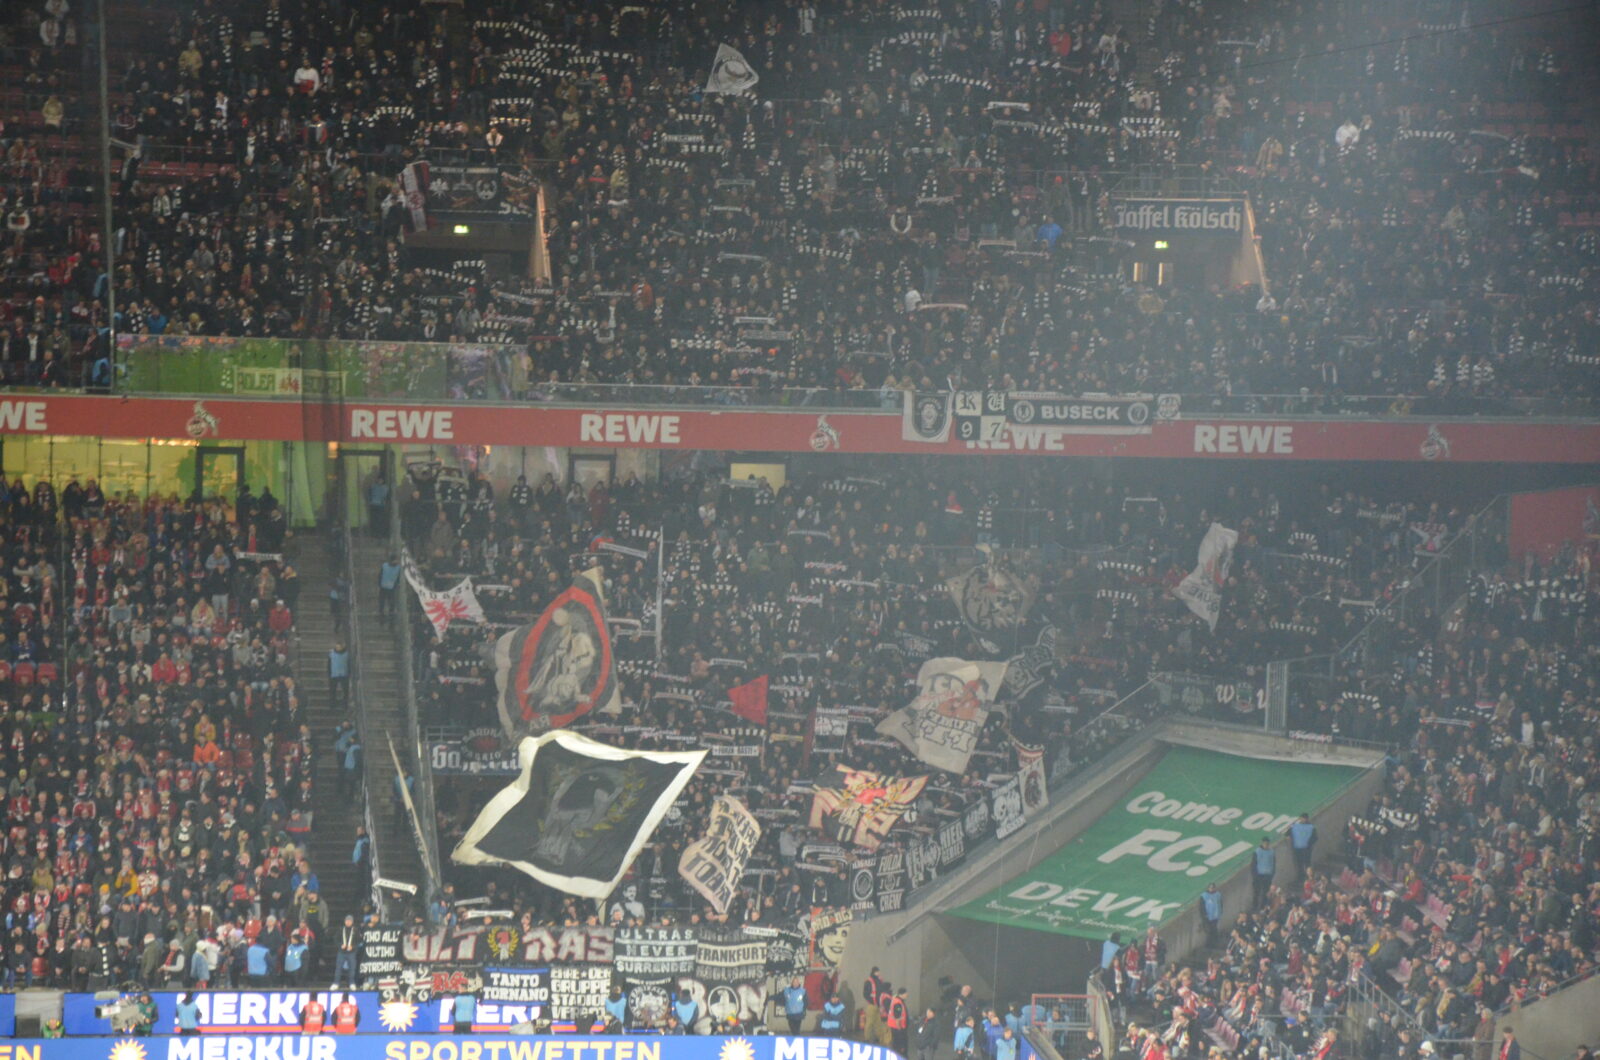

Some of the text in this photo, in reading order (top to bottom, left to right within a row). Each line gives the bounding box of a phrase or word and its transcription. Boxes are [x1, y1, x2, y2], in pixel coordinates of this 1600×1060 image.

[1174, 205, 1242, 232] Kölsch
[1041, 405, 1120, 420] BUSECK
[351, 410, 454, 439] REWE
[580, 414, 680, 443] REWE
[1194, 425, 1293, 453] REWE
[1126, 791, 1300, 834] Come on
[1097, 828, 1254, 877] FC!
[1008, 881, 1186, 921] DEVK
[620, 928, 694, 940] ULTRAS
[626, 944, 687, 957] NEVER
[697, 946, 766, 963] FRANKFURT
[616, 960, 694, 973] SURRENDER
[490, 972, 540, 987] TANTO
[550, 979, 611, 994] GRUPPE
[483, 987, 549, 1001] TORNANO
[167, 1036, 337, 1060] MERKUR
[385, 1041, 661, 1060] SPORTWETTEN
